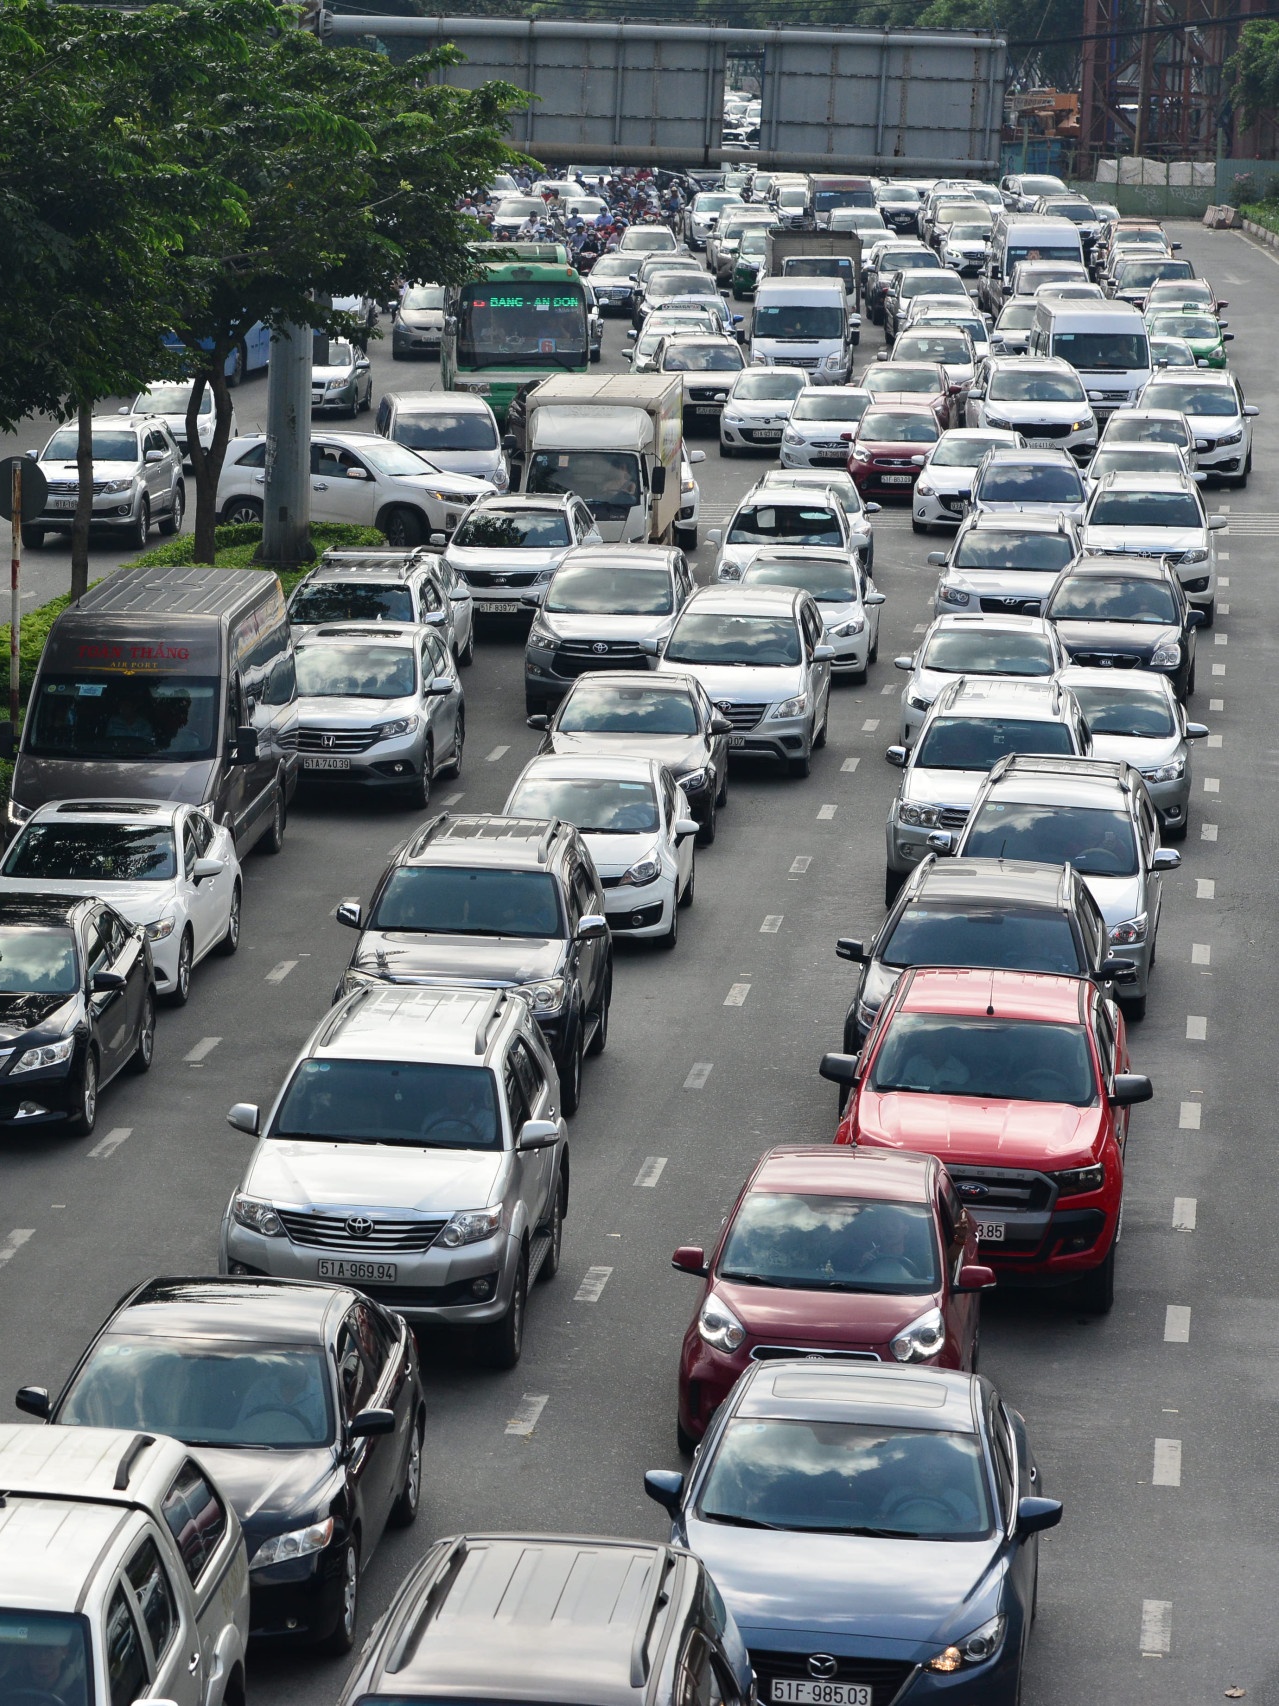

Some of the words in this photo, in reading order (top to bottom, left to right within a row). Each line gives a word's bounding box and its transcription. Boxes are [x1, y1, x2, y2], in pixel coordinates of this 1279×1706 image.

[489, 297, 523, 307] BANG
[320, 1261, 393, 1280] 51A-969.94
[773, 1681, 869, 1705] 51F-985.03
